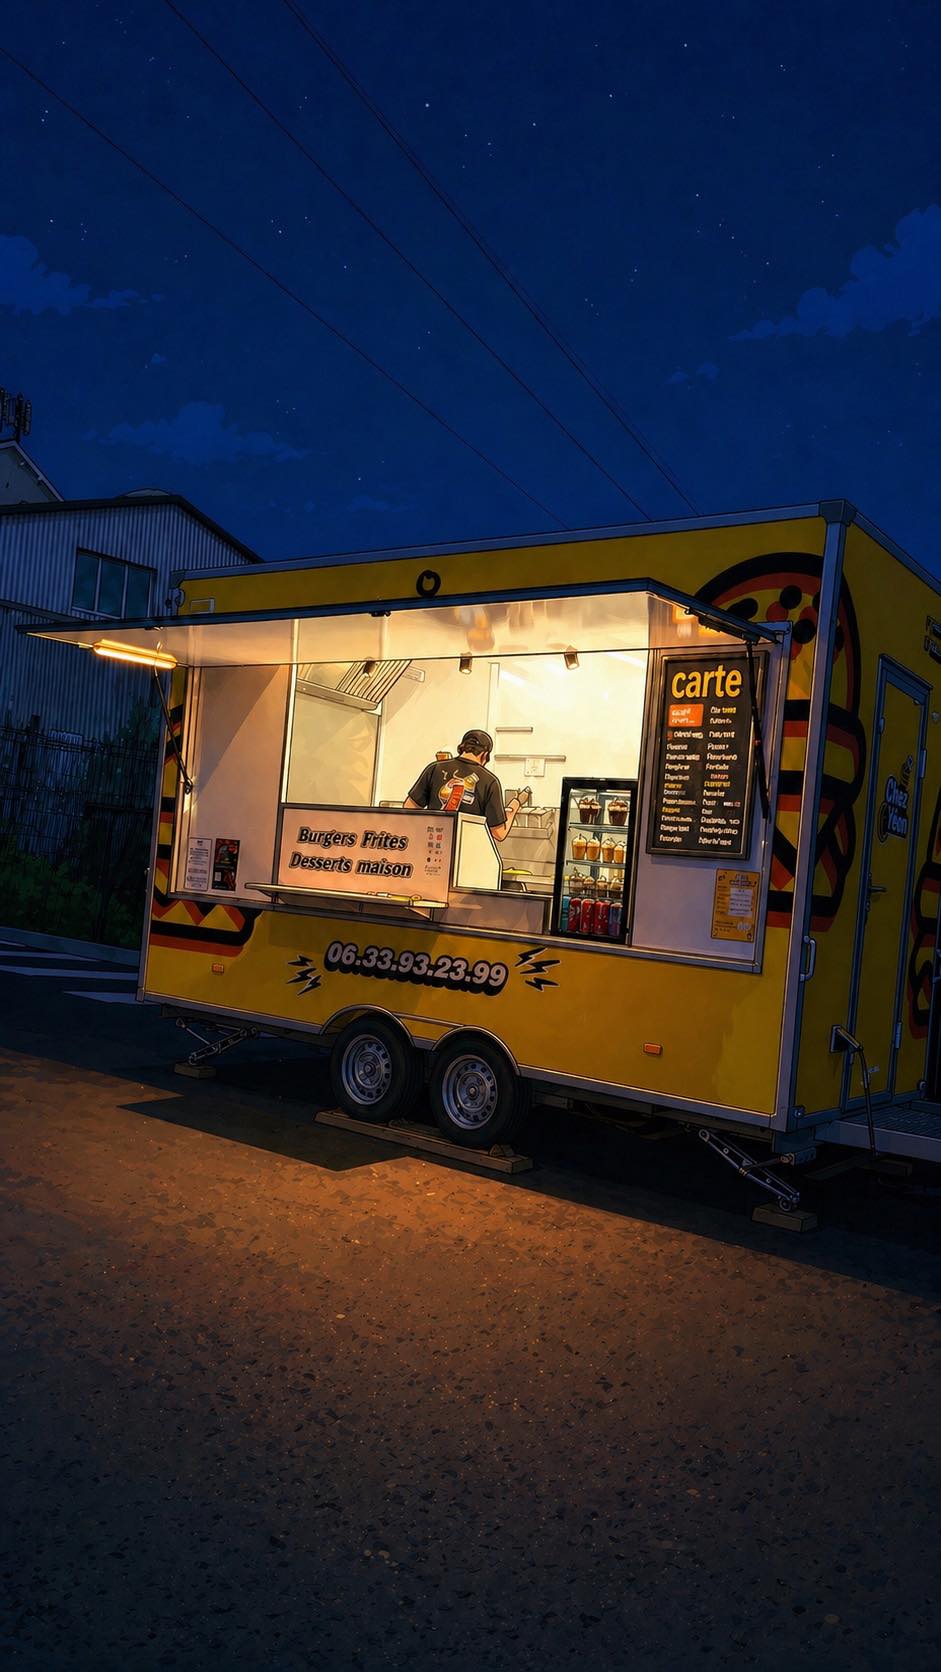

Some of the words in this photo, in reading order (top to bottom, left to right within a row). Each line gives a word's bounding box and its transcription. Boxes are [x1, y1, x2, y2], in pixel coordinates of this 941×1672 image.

[671, 664, 742, 699] carte
[297, 826, 357, 848] Burgers
[361, 829, 409, 851] Frites
[289, 851, 352, 873] Desserts
[355, 858, 413, 878] maison
[325, 941, 508, 994] 06.33.93.23.99
